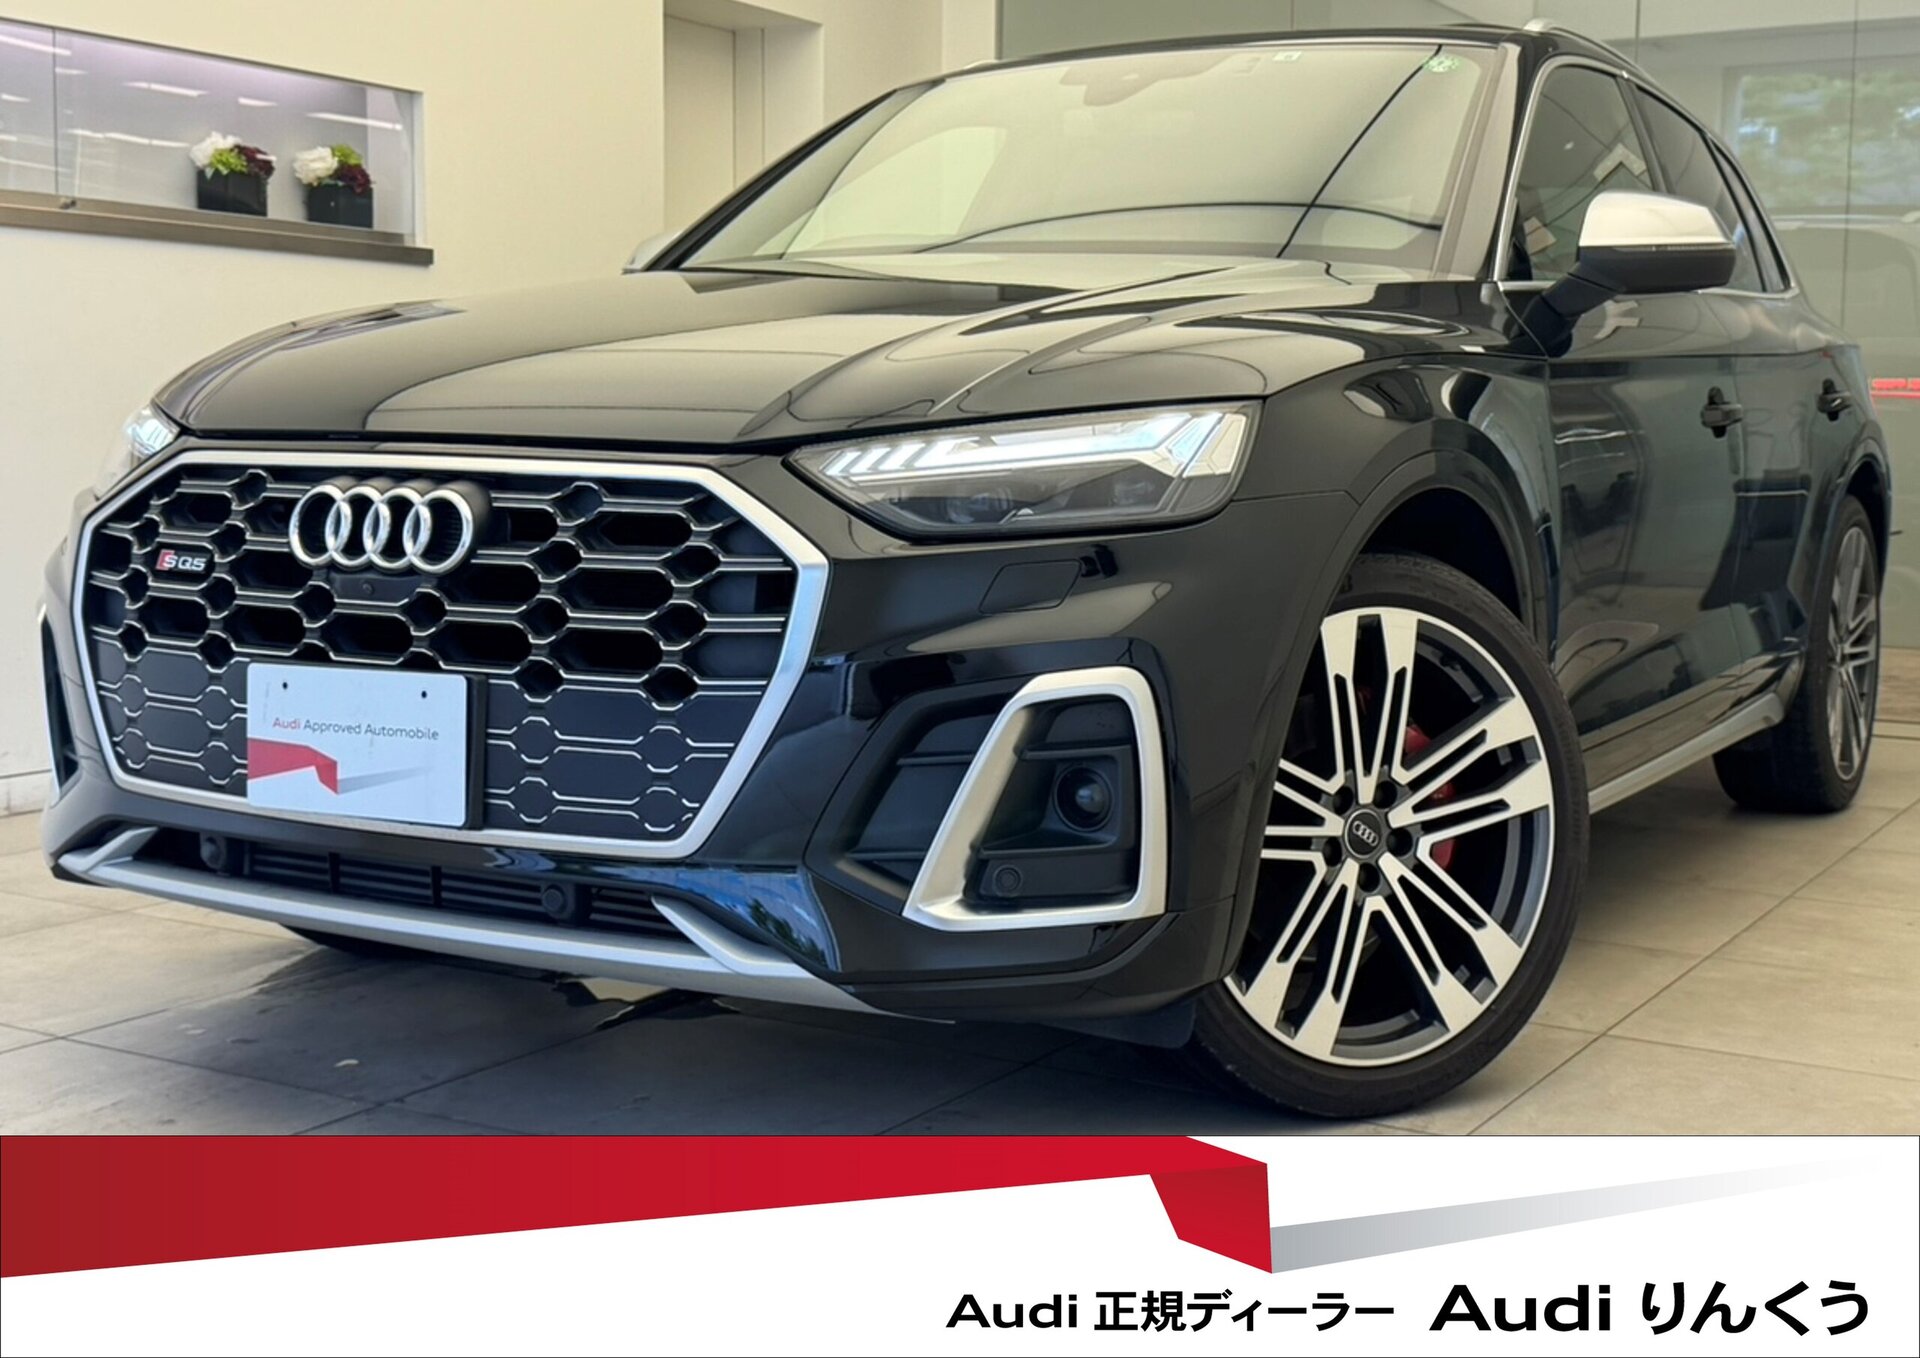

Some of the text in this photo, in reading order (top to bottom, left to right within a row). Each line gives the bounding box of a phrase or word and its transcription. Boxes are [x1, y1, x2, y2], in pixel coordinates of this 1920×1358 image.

[162, 554, 207, 571] SQ5
[272, 717, 439, 741] Audi Approved Automobile
